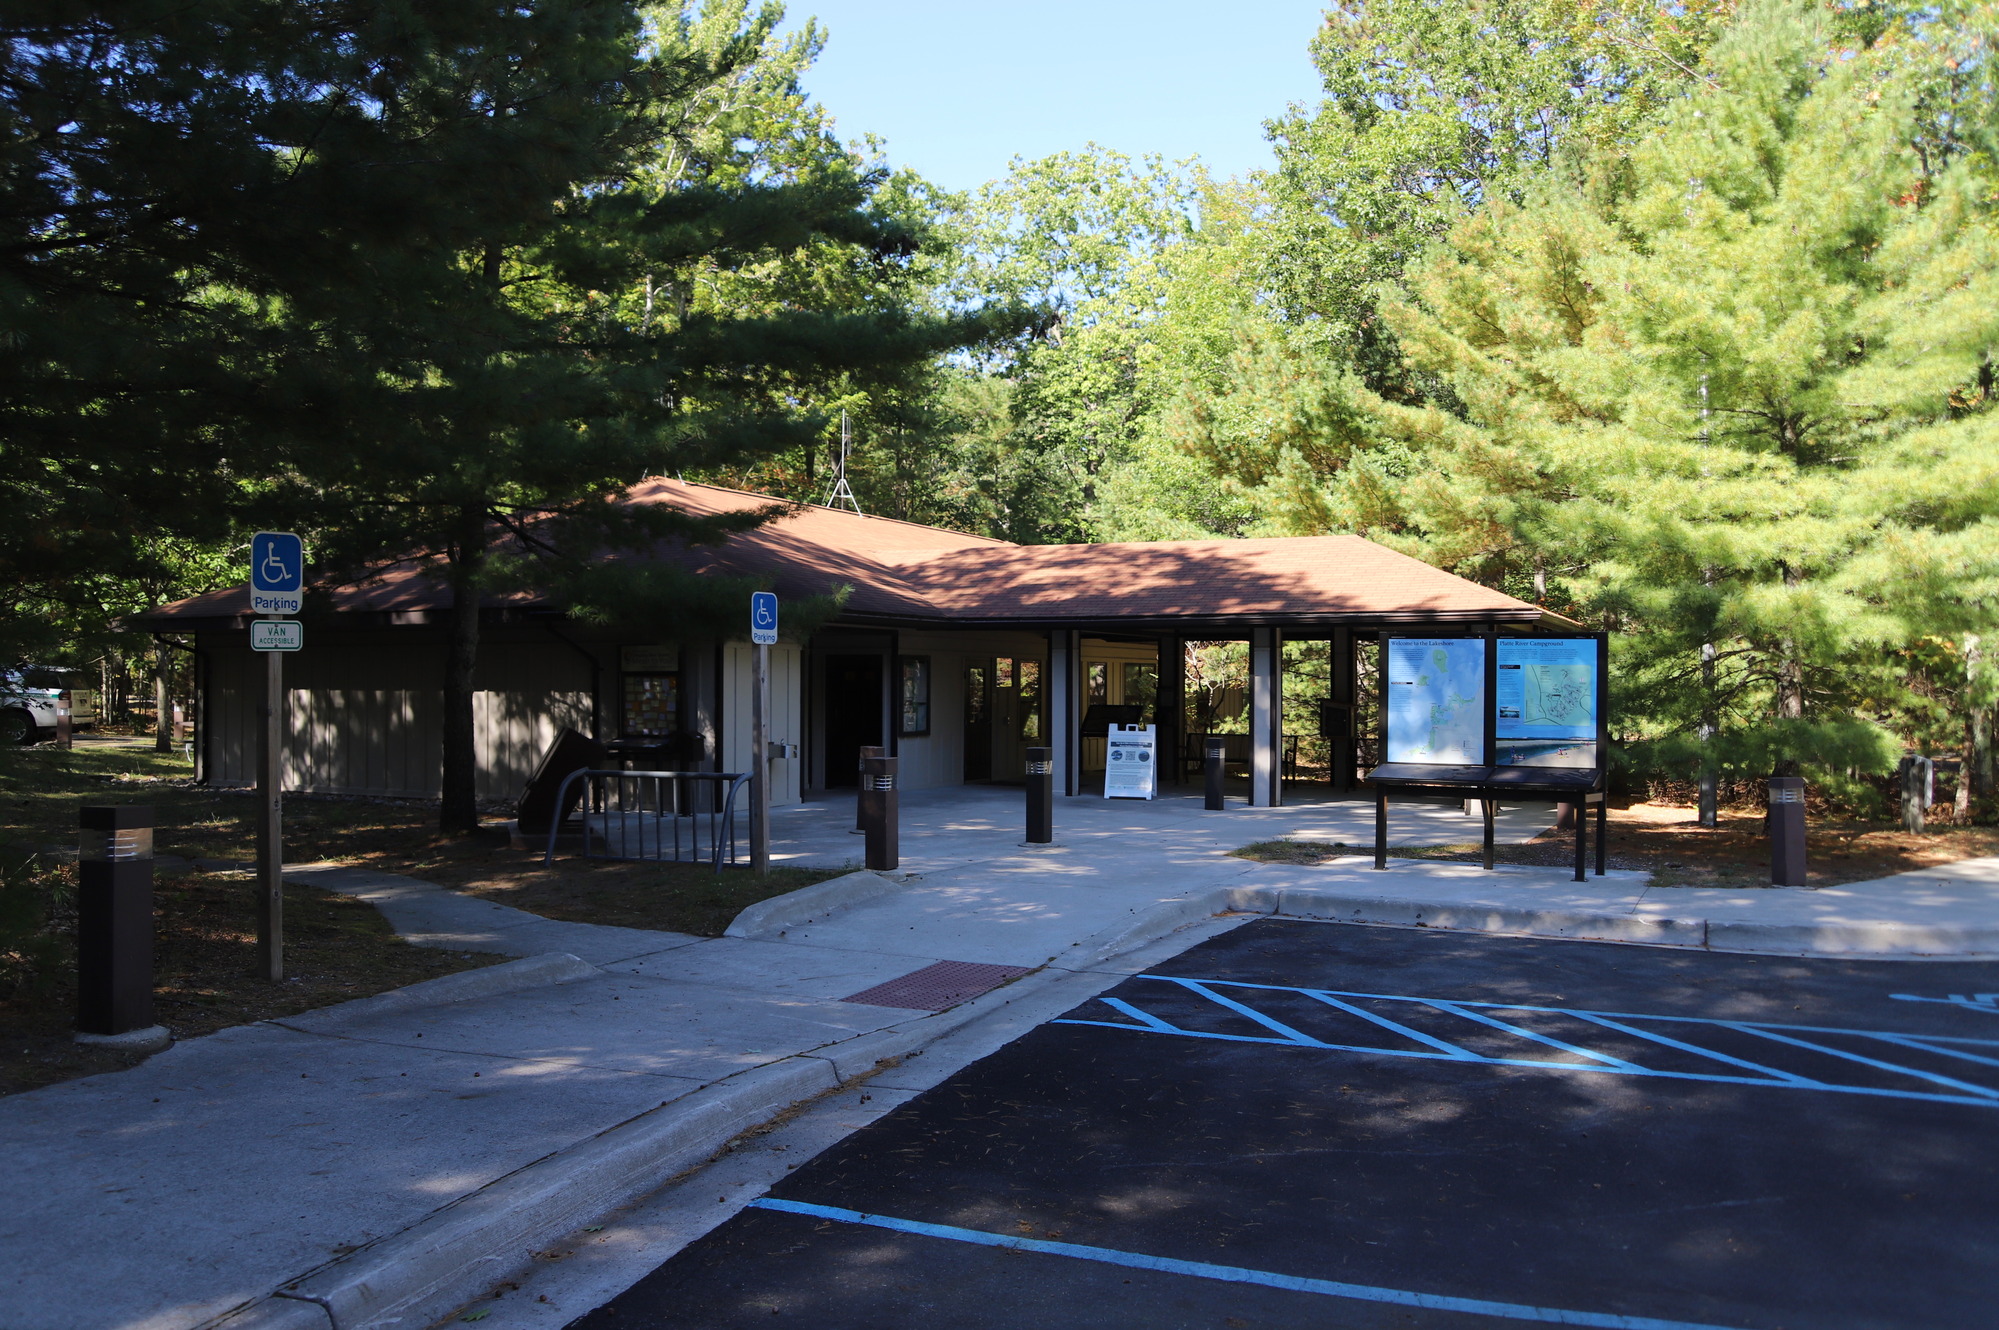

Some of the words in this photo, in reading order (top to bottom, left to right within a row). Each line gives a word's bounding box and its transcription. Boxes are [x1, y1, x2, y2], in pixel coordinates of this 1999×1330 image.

[255, 596, 298, 611] Parking
[267, 627, 286, 636] VAN
[259, 637, 295, 645] ACCESSIBLE
[754, 632, 776, 642] Parking
